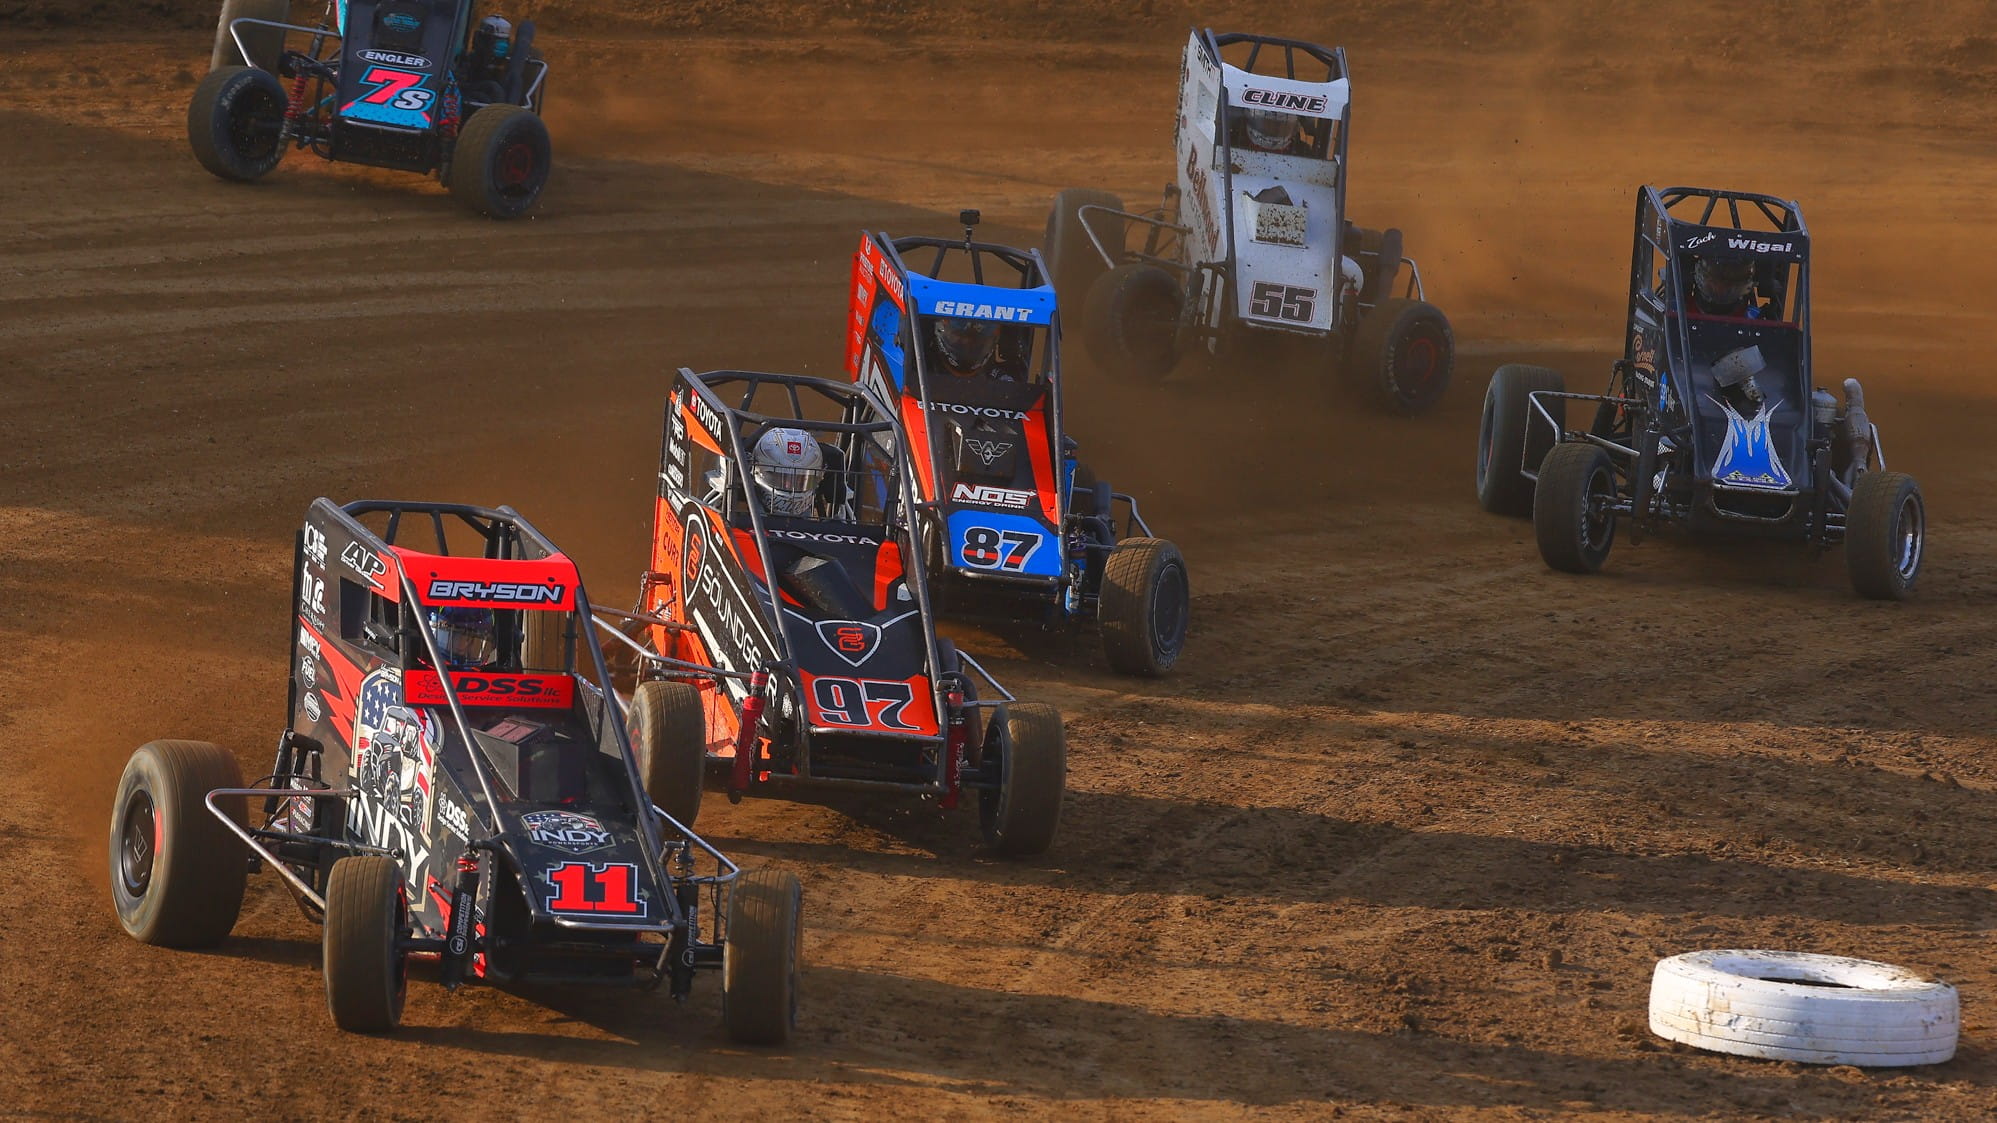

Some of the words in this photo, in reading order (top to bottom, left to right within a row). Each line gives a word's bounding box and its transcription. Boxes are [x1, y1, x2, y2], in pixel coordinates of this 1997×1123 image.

[364, 51, 425, 67] ENGLER
[1242, 88, 1328, 113] CLINE
[1686, 232, 1717, 249] Zach
[1728, 238, 1793, 253] Wigal
[884, 263, 904, 303] TOYOTA
[935, 300, 1033, 322] GRANT
[1249, 280, 1318, 323] 55
[696, 395, 722, 443] TOYOTA
[937, 402, 1031, 422] TOYOTA
[952, 483, 1036, 507] NOS
[952, 497, 992, 506] ENERGY
[767, 528, 880, 546] TOYOTA
[961, 526, 1043, 572] 87
[428, 580, 566, 605] BRYSON
[702, 564, 778, 708] SOUNDGER
[456, 677, 544, 696] DSS
[461, 694, 503, 702] Service
[812, 676, 925, 731] 97
[445, 799, 466, 831] DSS
[530, 830, 611, 843] INDY
[547, 861, 647, 917] 11
